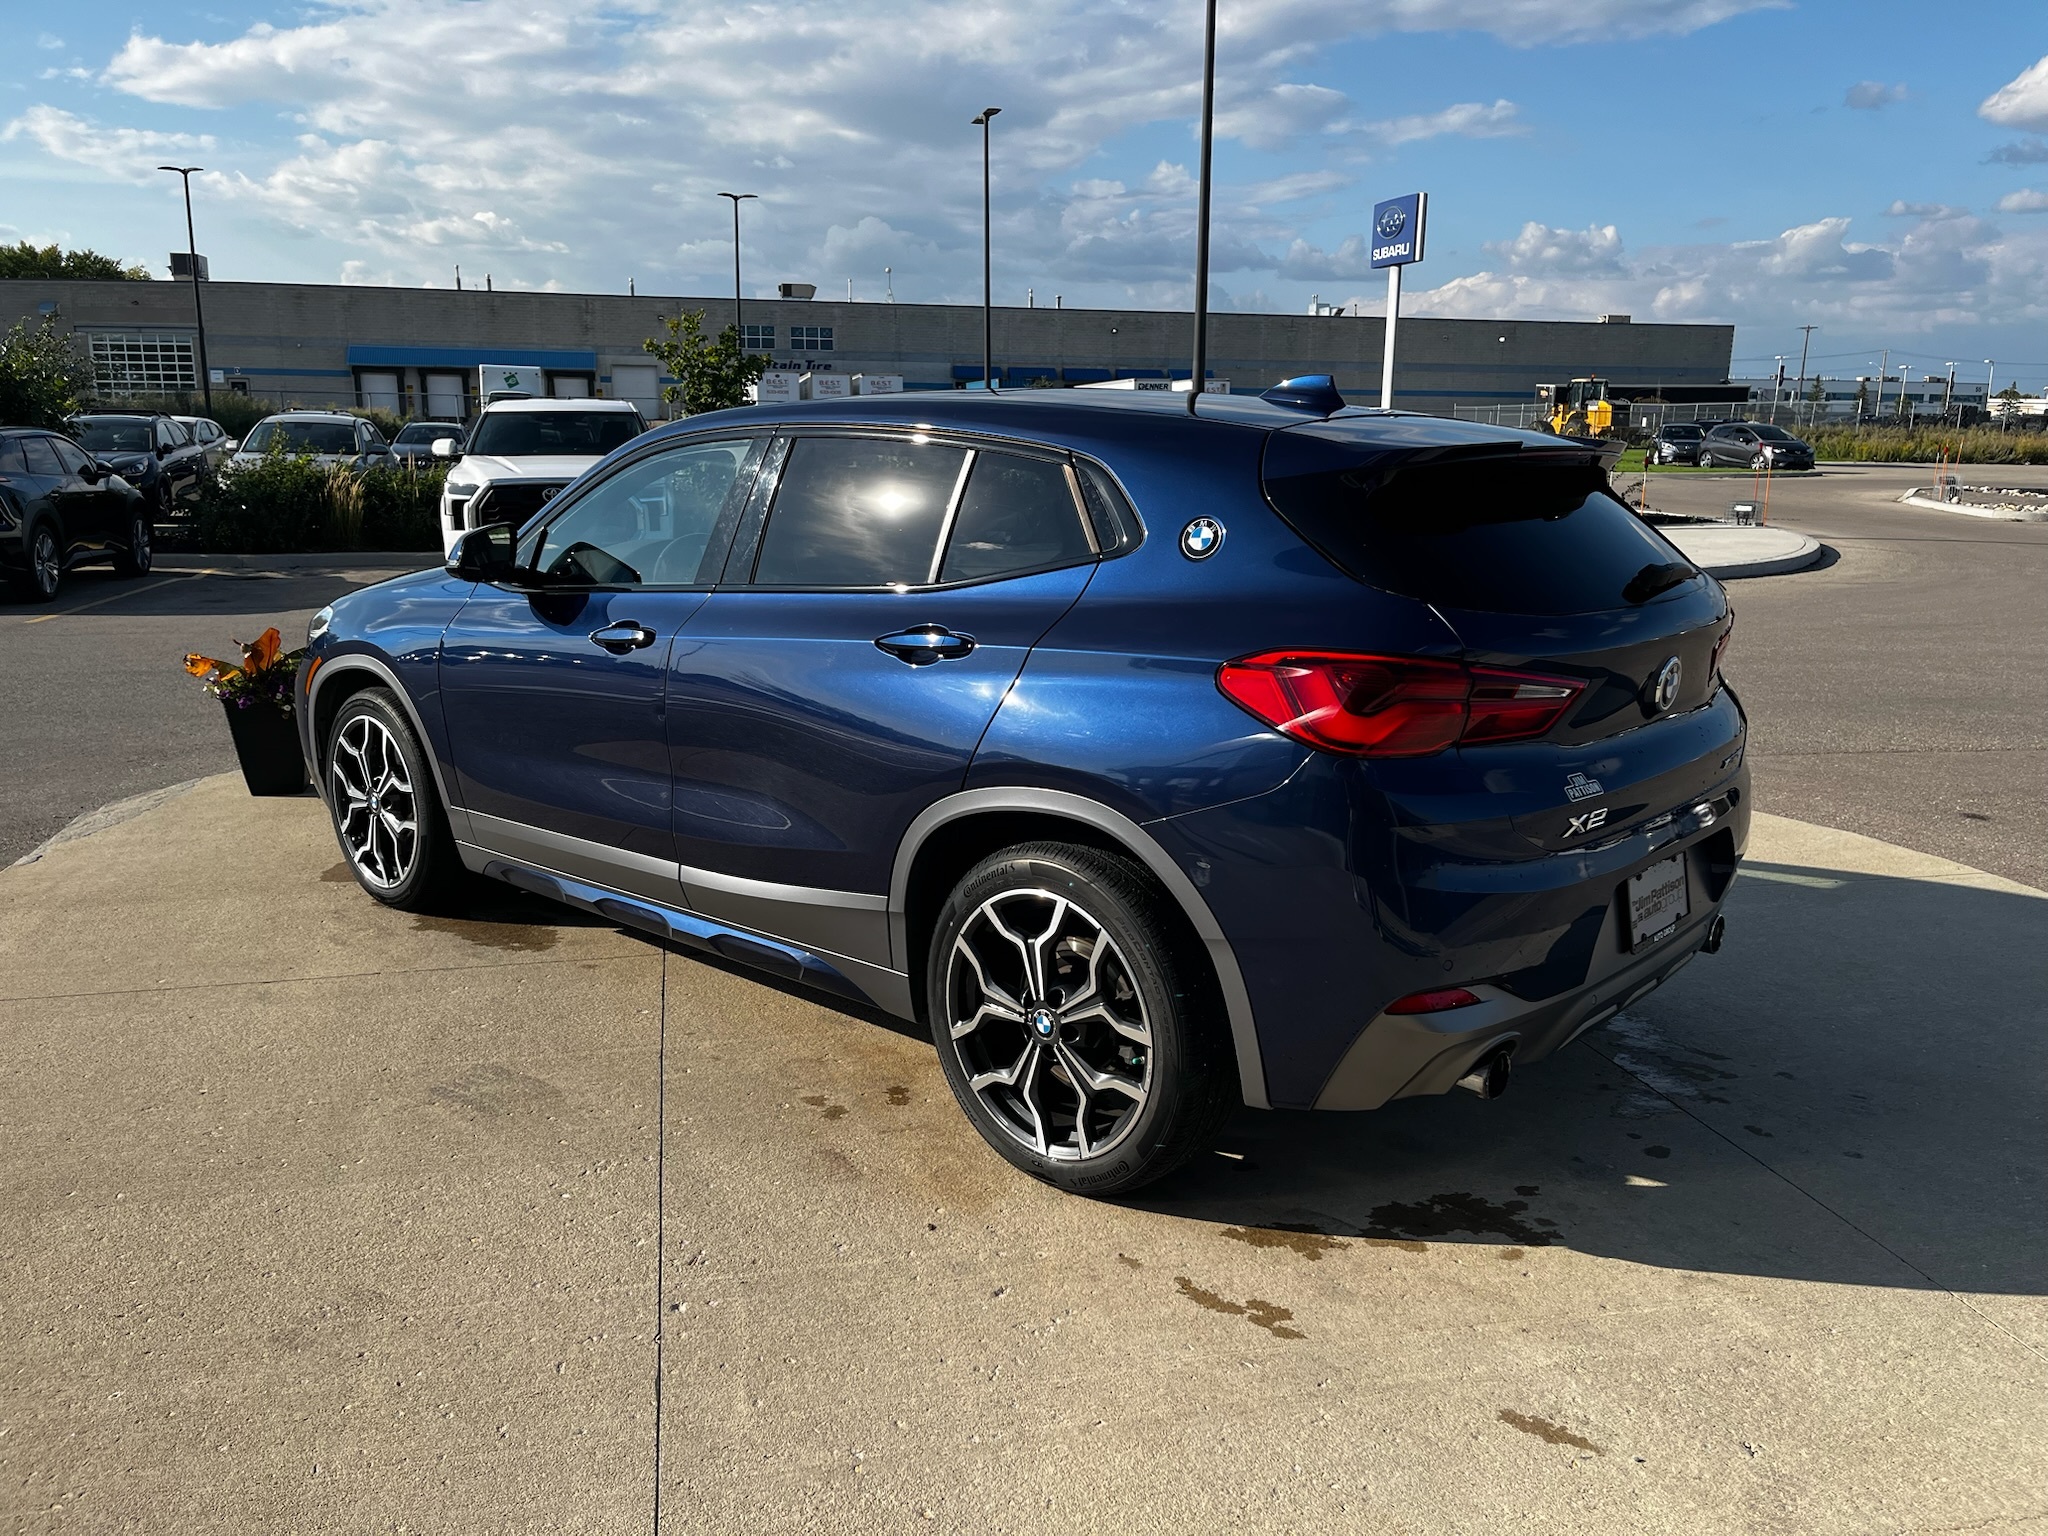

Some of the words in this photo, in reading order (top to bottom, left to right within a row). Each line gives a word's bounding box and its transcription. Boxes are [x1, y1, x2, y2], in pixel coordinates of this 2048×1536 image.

[1372, 242, 1410, 261] SUBARU
[805, 360, 832, 370] Tire
[1187, 520, 1218, 533] BMW
[1571, 775, 1587, 787] JIM
[1567, 782, 1601, 799] PATTISON
[1562, 807, 1608, 839] X2
[963, 864, 1008, 898] Continental
